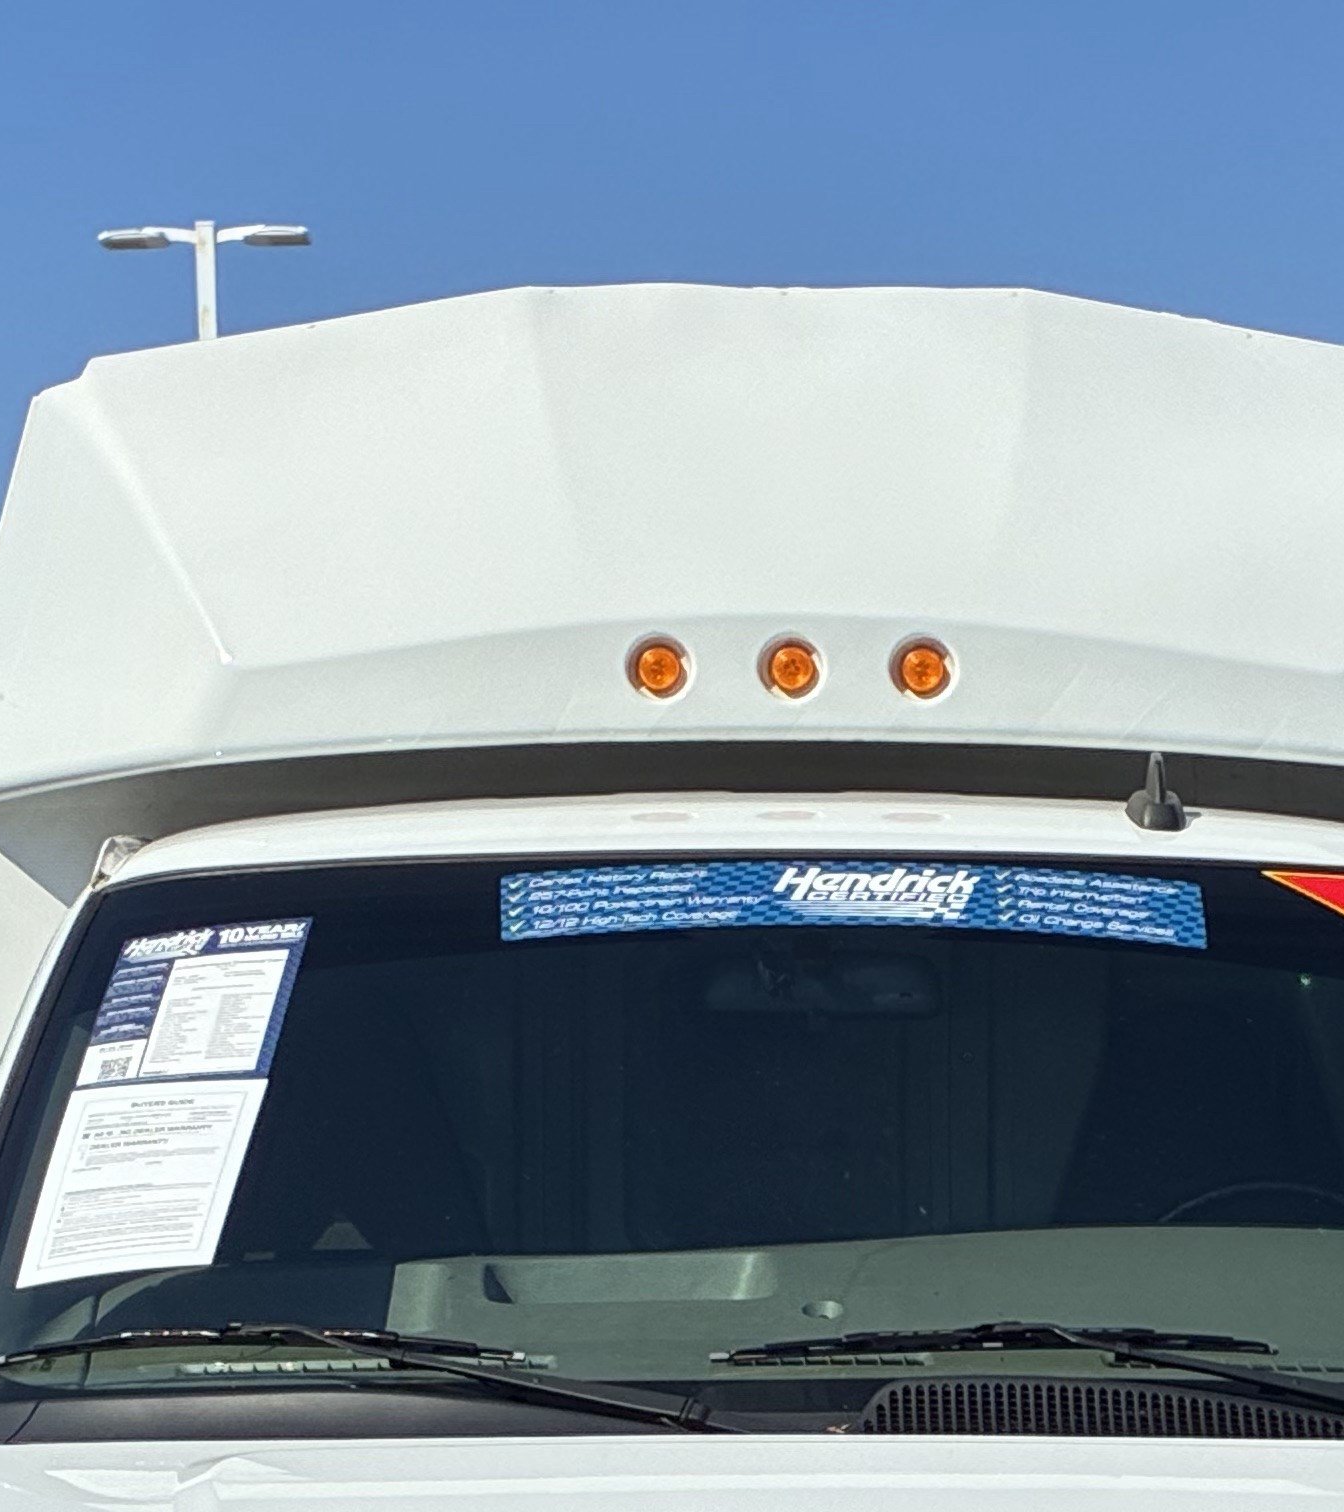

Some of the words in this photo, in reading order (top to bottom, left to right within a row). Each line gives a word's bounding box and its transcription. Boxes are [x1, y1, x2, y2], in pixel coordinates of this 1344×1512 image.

[587, 872, 646, 884] History
[773, 867, 980, 900] Hendrick
[806, 891, 969, 902] CERTIFIED
[661, 910, 741, 922] Coverage
[1073, 903, 1151, 919] Coverage
[1043, 915, 1104, 929] Change
[219, 927, 244, 944] 10
